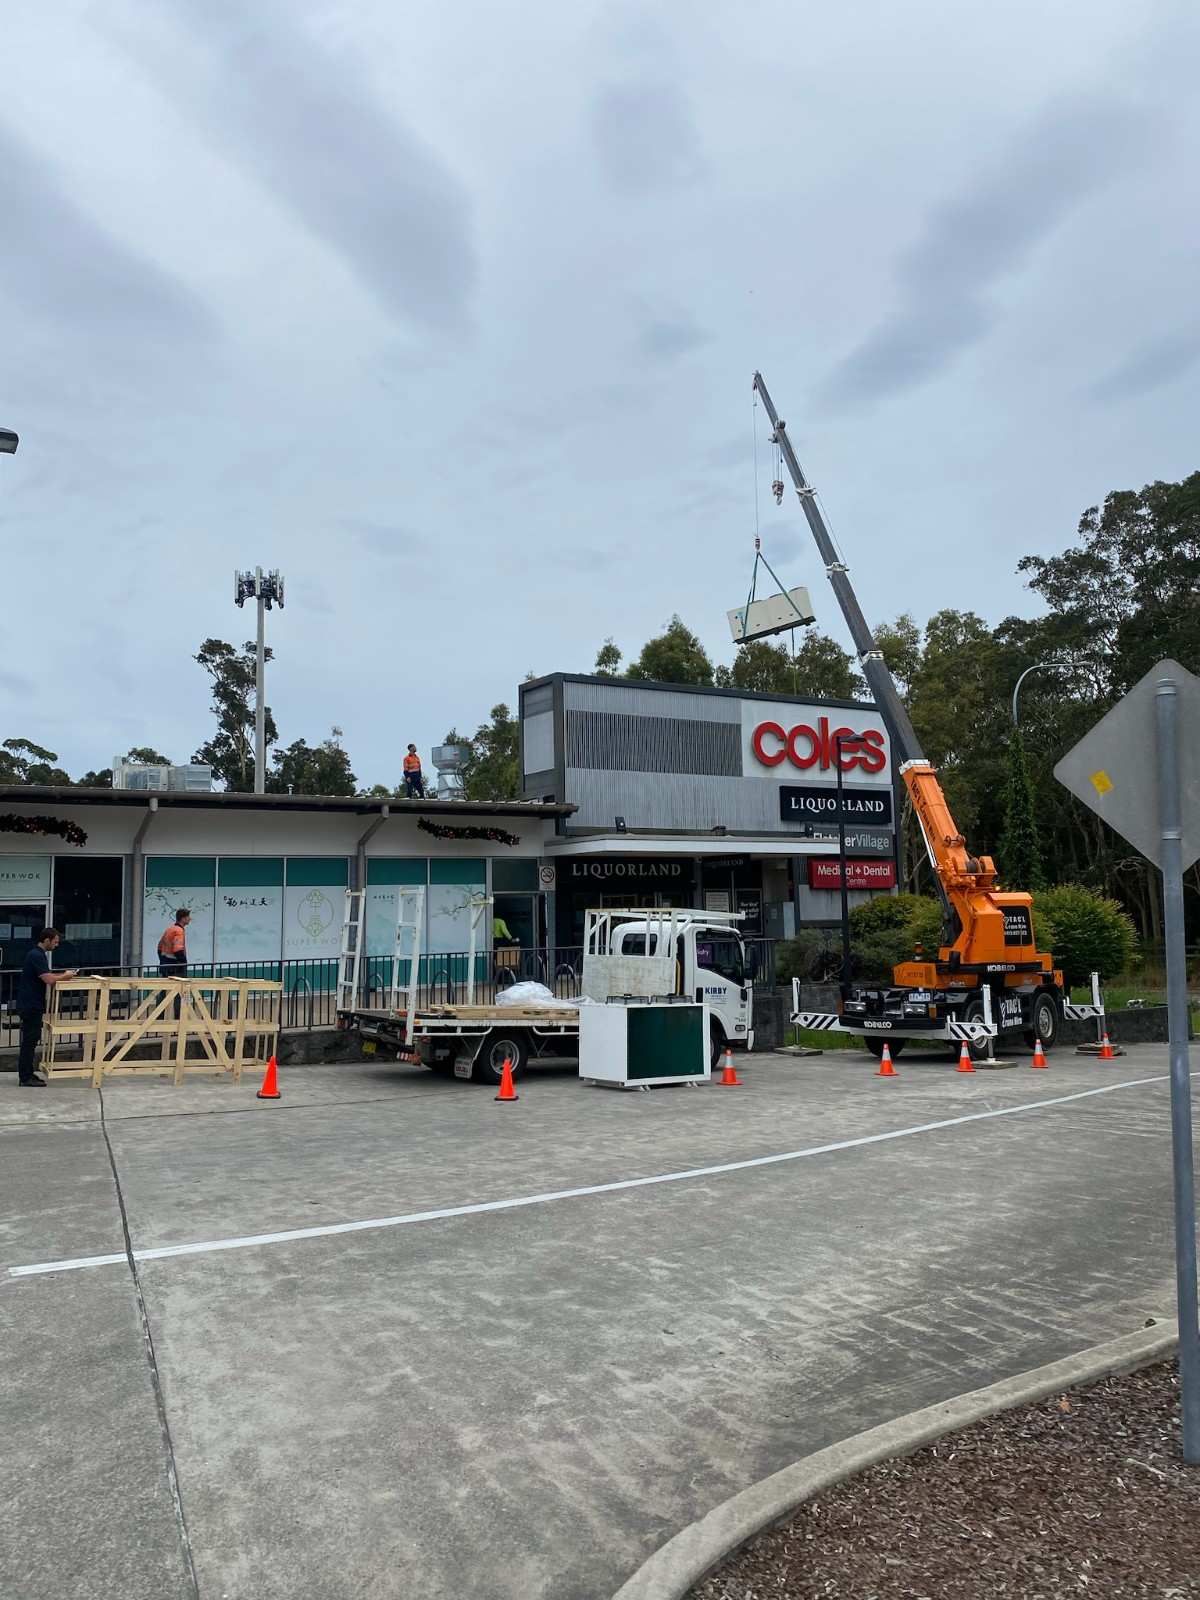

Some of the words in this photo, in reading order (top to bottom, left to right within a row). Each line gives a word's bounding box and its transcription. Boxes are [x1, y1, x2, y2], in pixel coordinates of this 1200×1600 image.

[752, 716, 886, 774] coles
[572, 863, 681, 878] LIQUORLAND
[817, 864, 854, 876] Medial
[863, 865, 890, 876] Dental
[987, 964, 1016, 972] KOBELCO
[705, 987, 727, 995] KIRBY
[863, 1021, 892, 1029] KOBELCO
